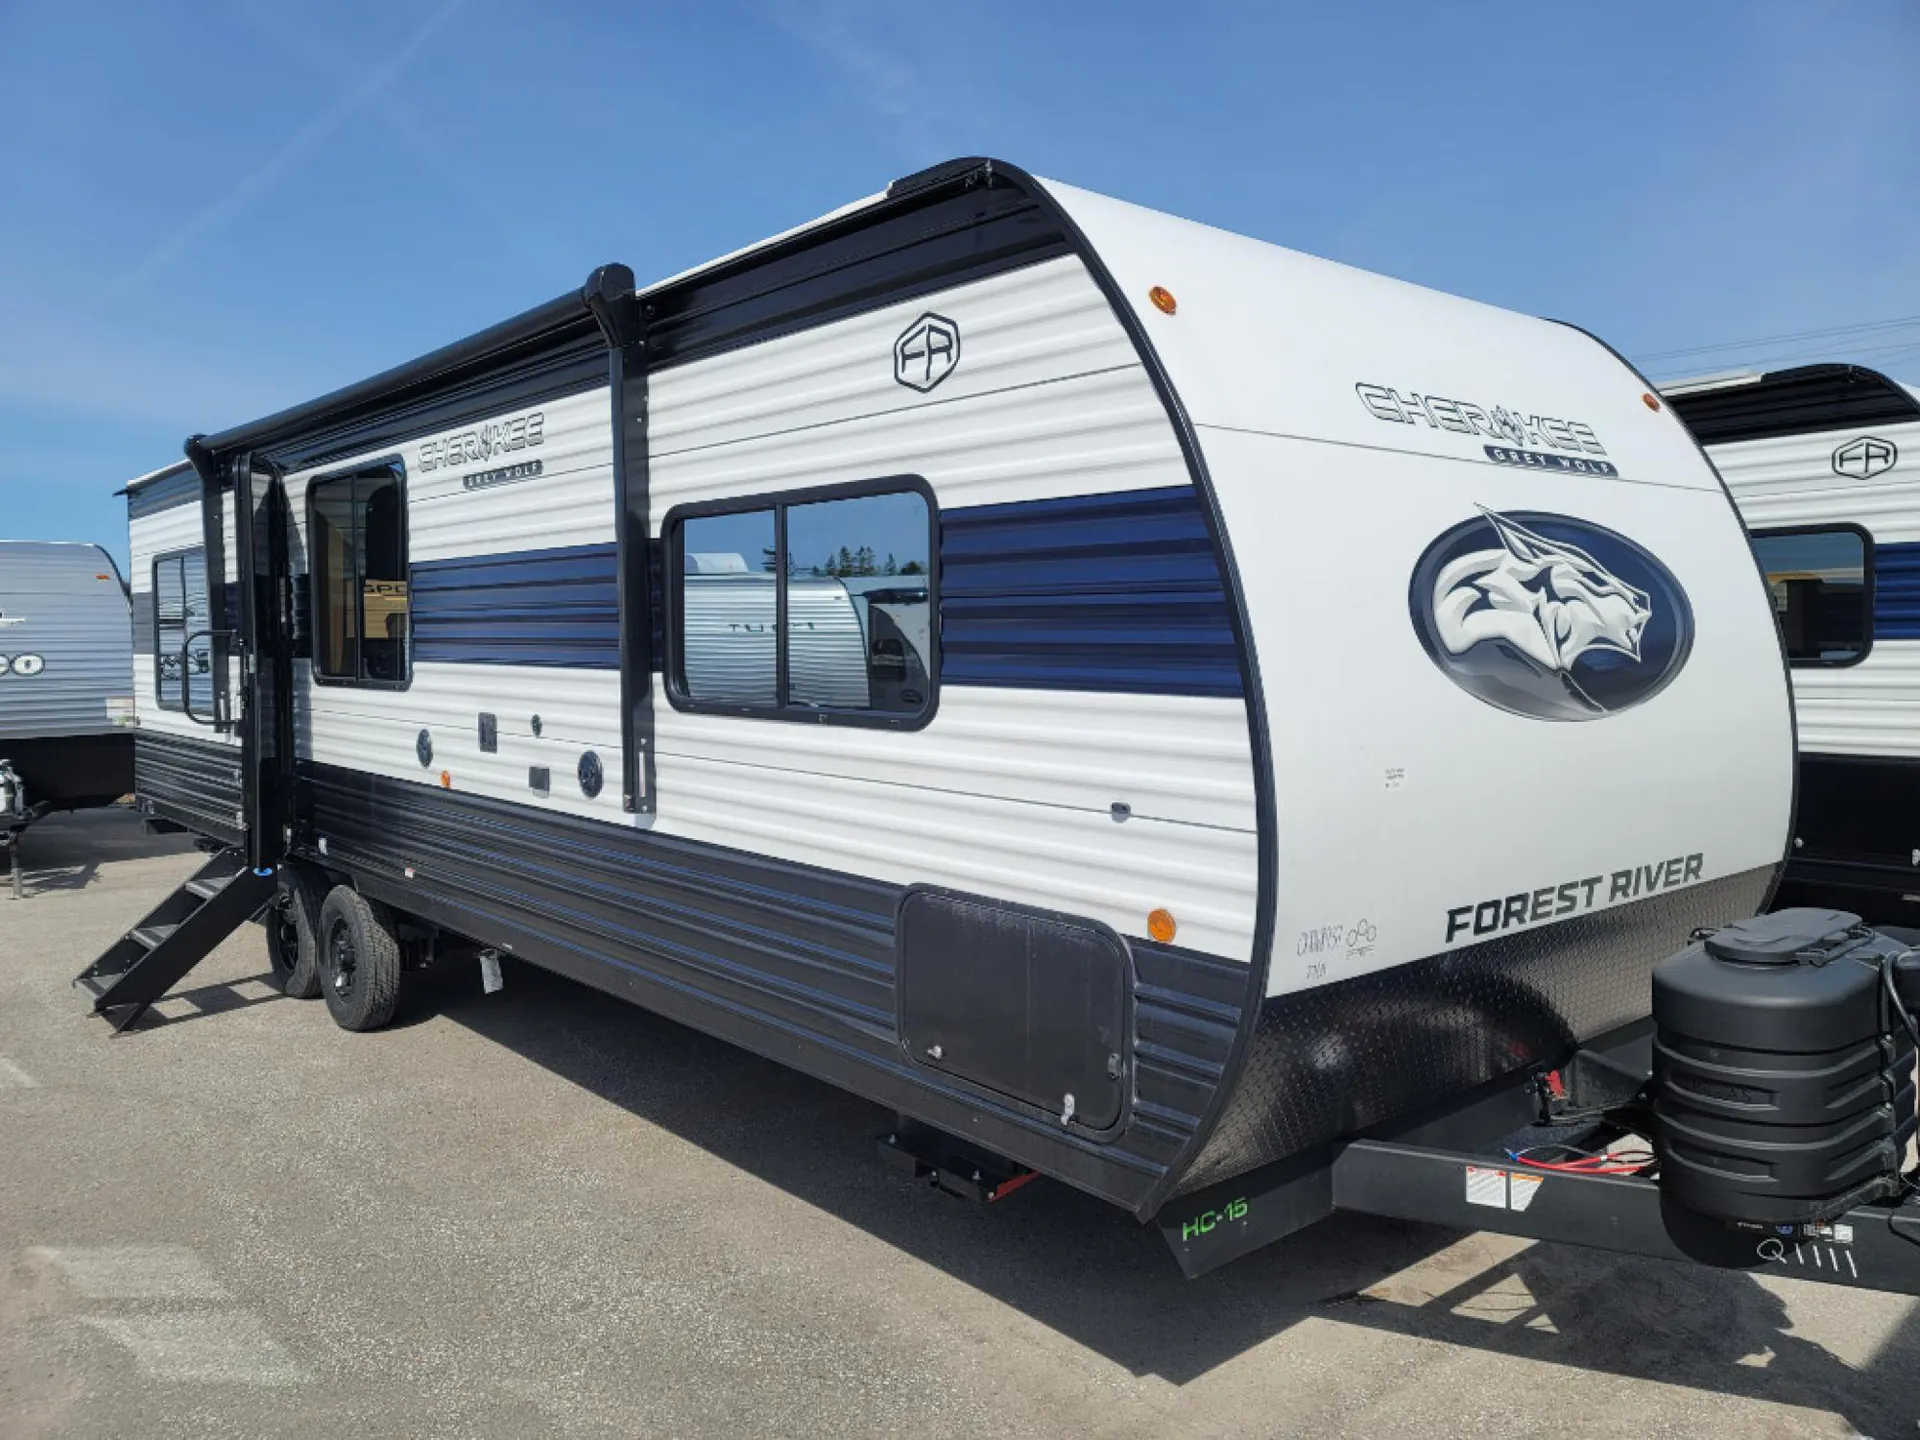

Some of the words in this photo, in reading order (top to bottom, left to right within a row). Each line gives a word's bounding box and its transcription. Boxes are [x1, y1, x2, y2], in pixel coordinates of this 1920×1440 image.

[898, 321, 955, 384] FR
[418, 411, 545, 473] CHEROKEE
[1355, 381, 1608, 456] CHEROKEE
[504, 462, 538, 478] WOLF
[1493, 448, 1546, 467] GREY
[1557, 456, 1610, 474] WOLF
[1445, 875, 1604, 944] FOREST
[1609, 852, 1704, 902] RIVER
[1182, 1196, 1248, 1242] HC-15
